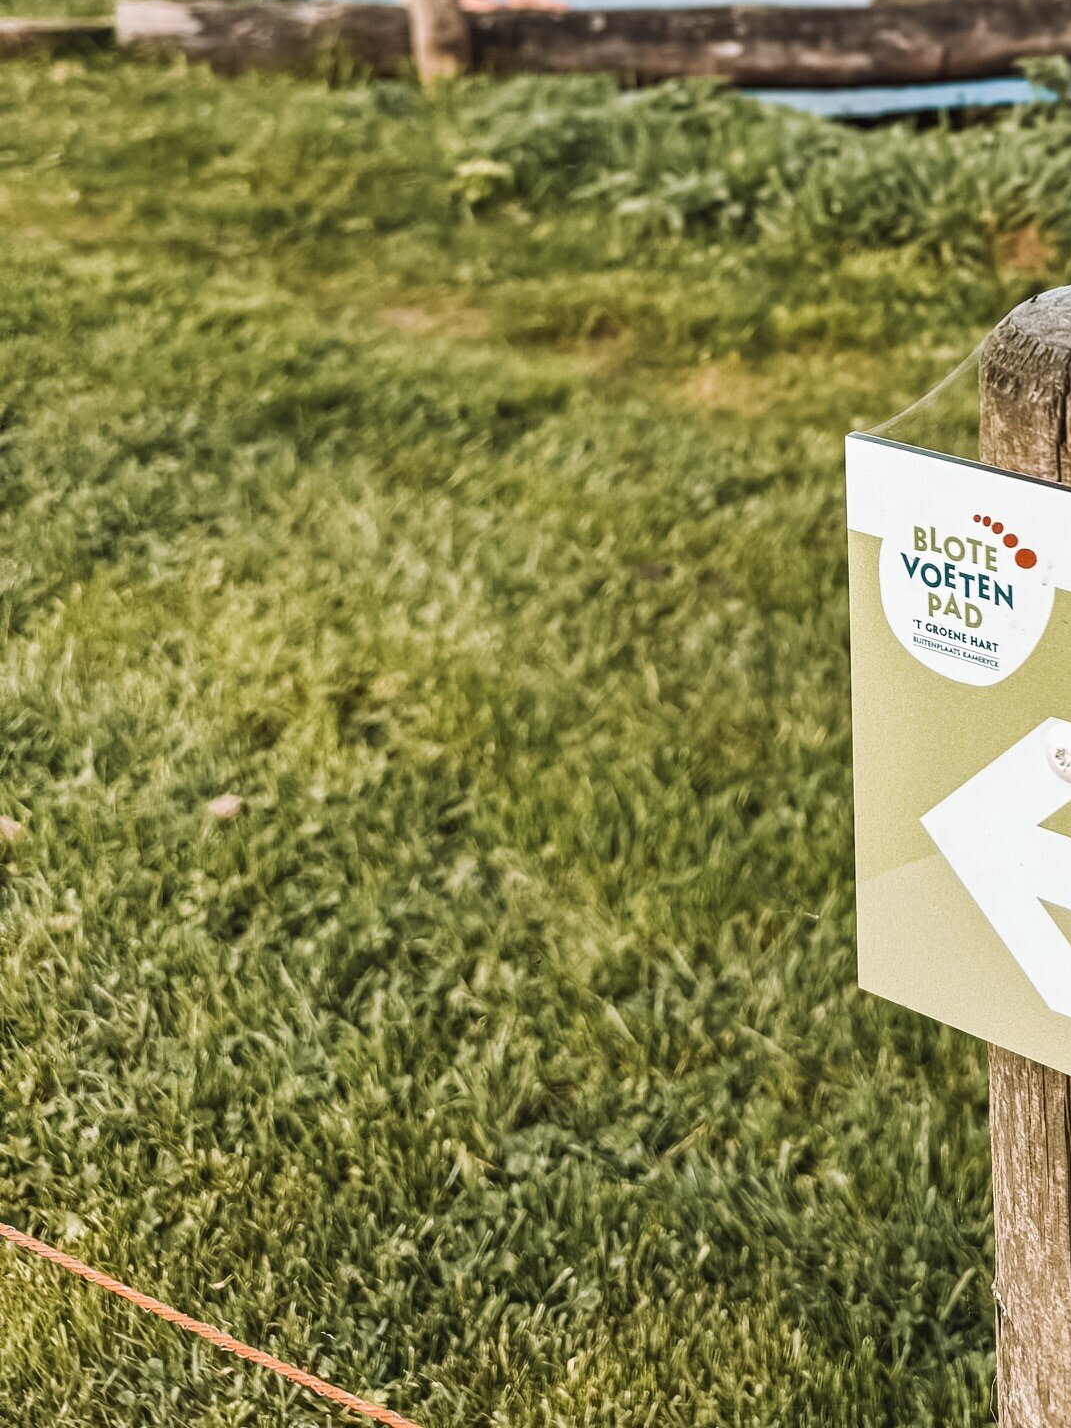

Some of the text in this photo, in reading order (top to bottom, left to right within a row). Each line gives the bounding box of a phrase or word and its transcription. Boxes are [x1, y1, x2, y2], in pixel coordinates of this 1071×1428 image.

[914, 525, 997, 572] BLOTE
[900, 552, 1014, 610] VOETEN
[927, 592, 983, 629] PAD
[913, 636, 960, 656] BUITENPLAATS
[925, 623, 967, 643] GROENE
[970, 636, 999, 653] HART
